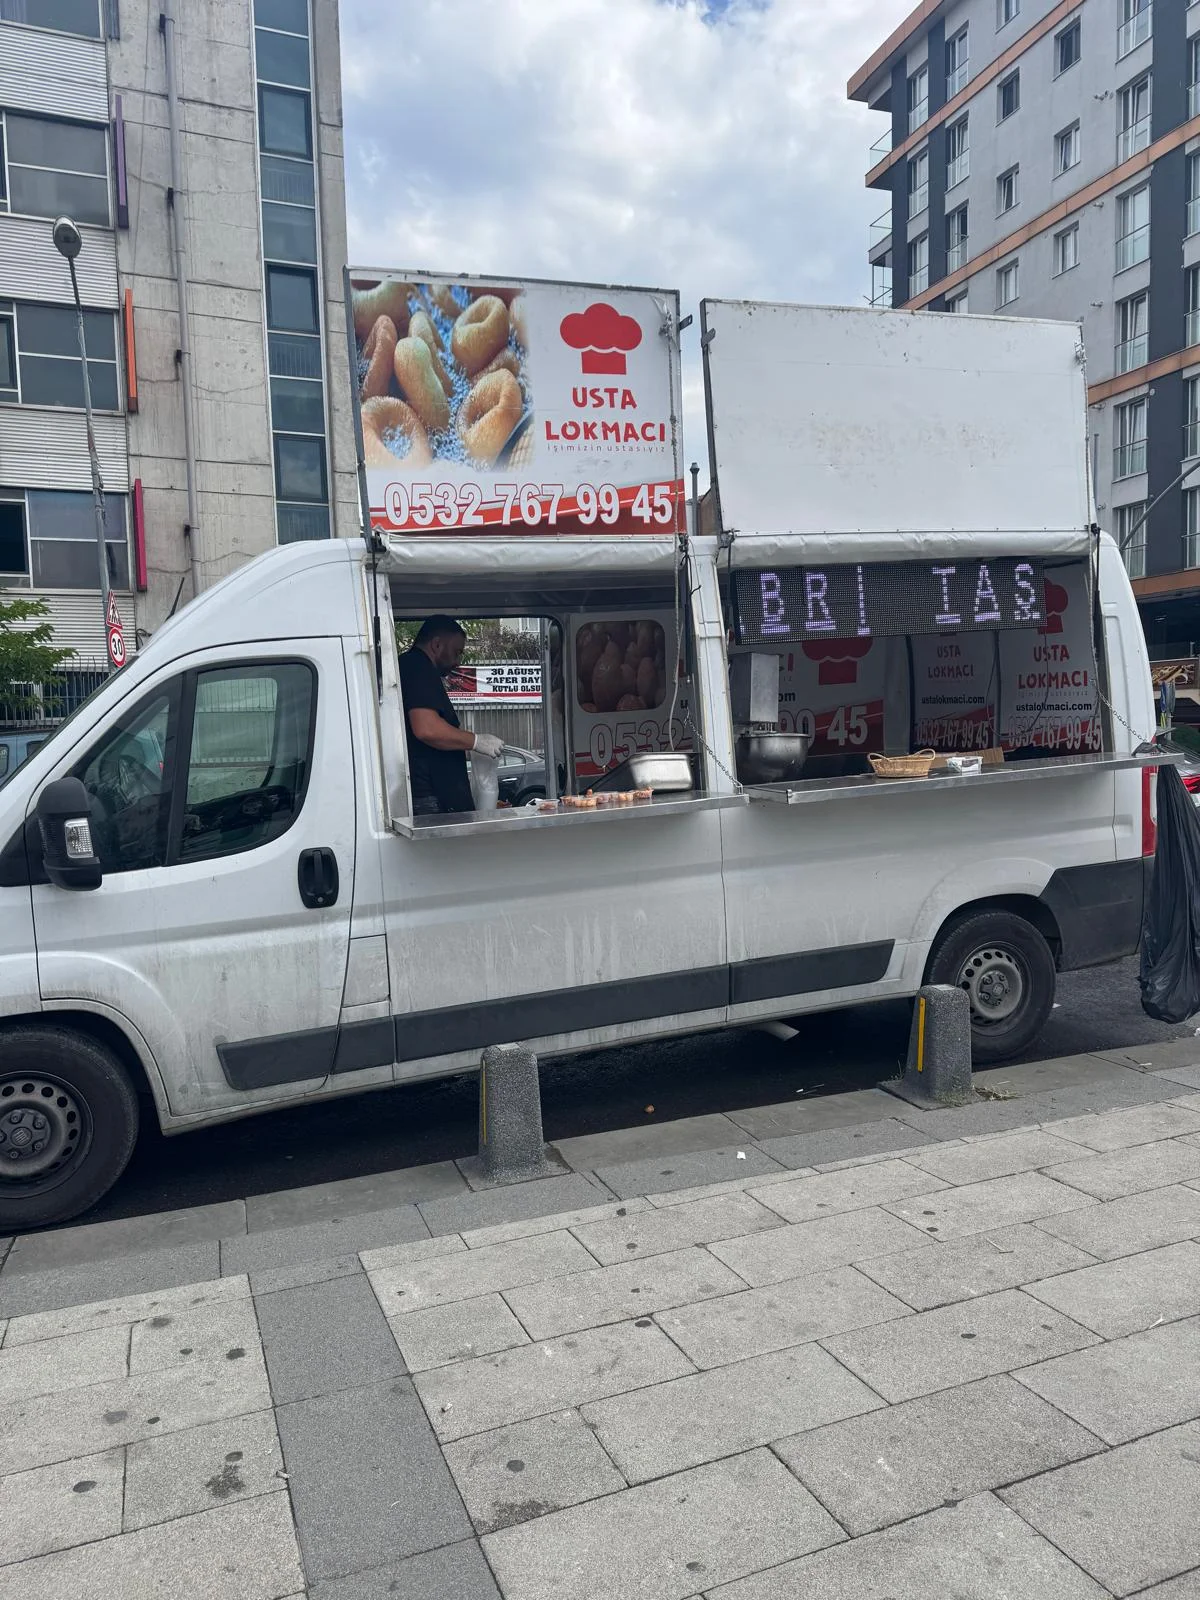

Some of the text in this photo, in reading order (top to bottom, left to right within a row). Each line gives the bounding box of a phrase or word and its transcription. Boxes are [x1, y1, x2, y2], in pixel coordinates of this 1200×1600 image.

[572, 387, 637, 410] USTA
[545, 420, 666, 443] LOKMACI
[385, 482, 673, 526] 0532 767 99 45
[112, 638, 123, 656] 30
[937, 645, 961, 658] USTA
[1033, 644, 1070, 662] USTA
[486, 676, 541, 684] ZAFER BAY
[491, 668, 504, 676] 30
[928, 664, 974, 679] LOKMACI
[1018, 670, 1088, 689] LOKMACI
[1016, 702, 1092, 711] ustalokmaci.com
[827, 705, 868, 746] 45
[1065, 715, 1082, 750] 99
[590, 718, 685, 768] 0532
